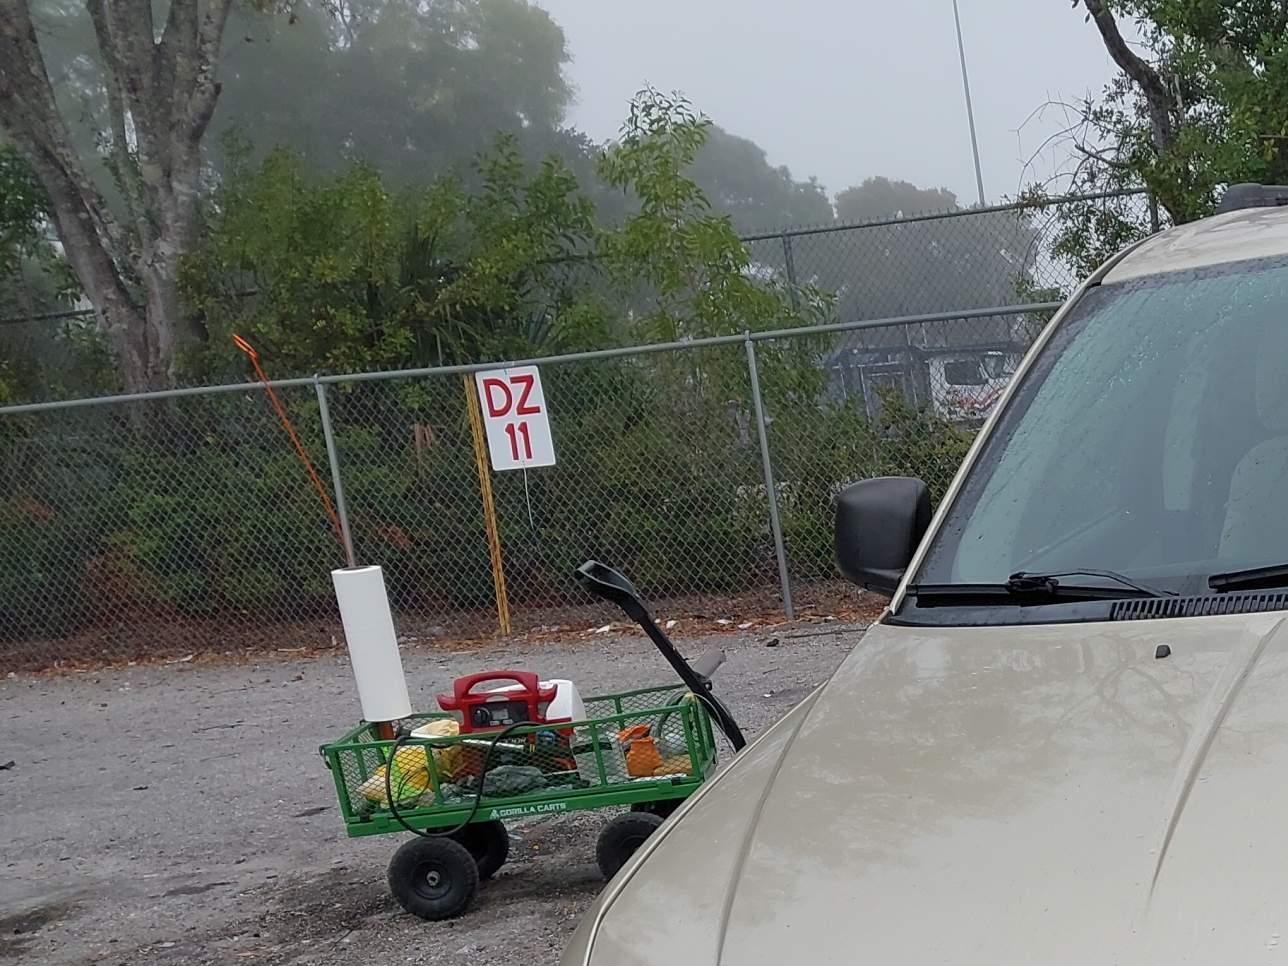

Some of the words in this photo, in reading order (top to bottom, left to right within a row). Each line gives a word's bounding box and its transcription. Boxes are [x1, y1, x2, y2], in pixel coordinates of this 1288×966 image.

[482, 374, 541, 418] DZ
[504, 421, 533, 461] 11
[500, 806, 536, 817] GORILLA
[536, 802, 567, 812] CARTS
